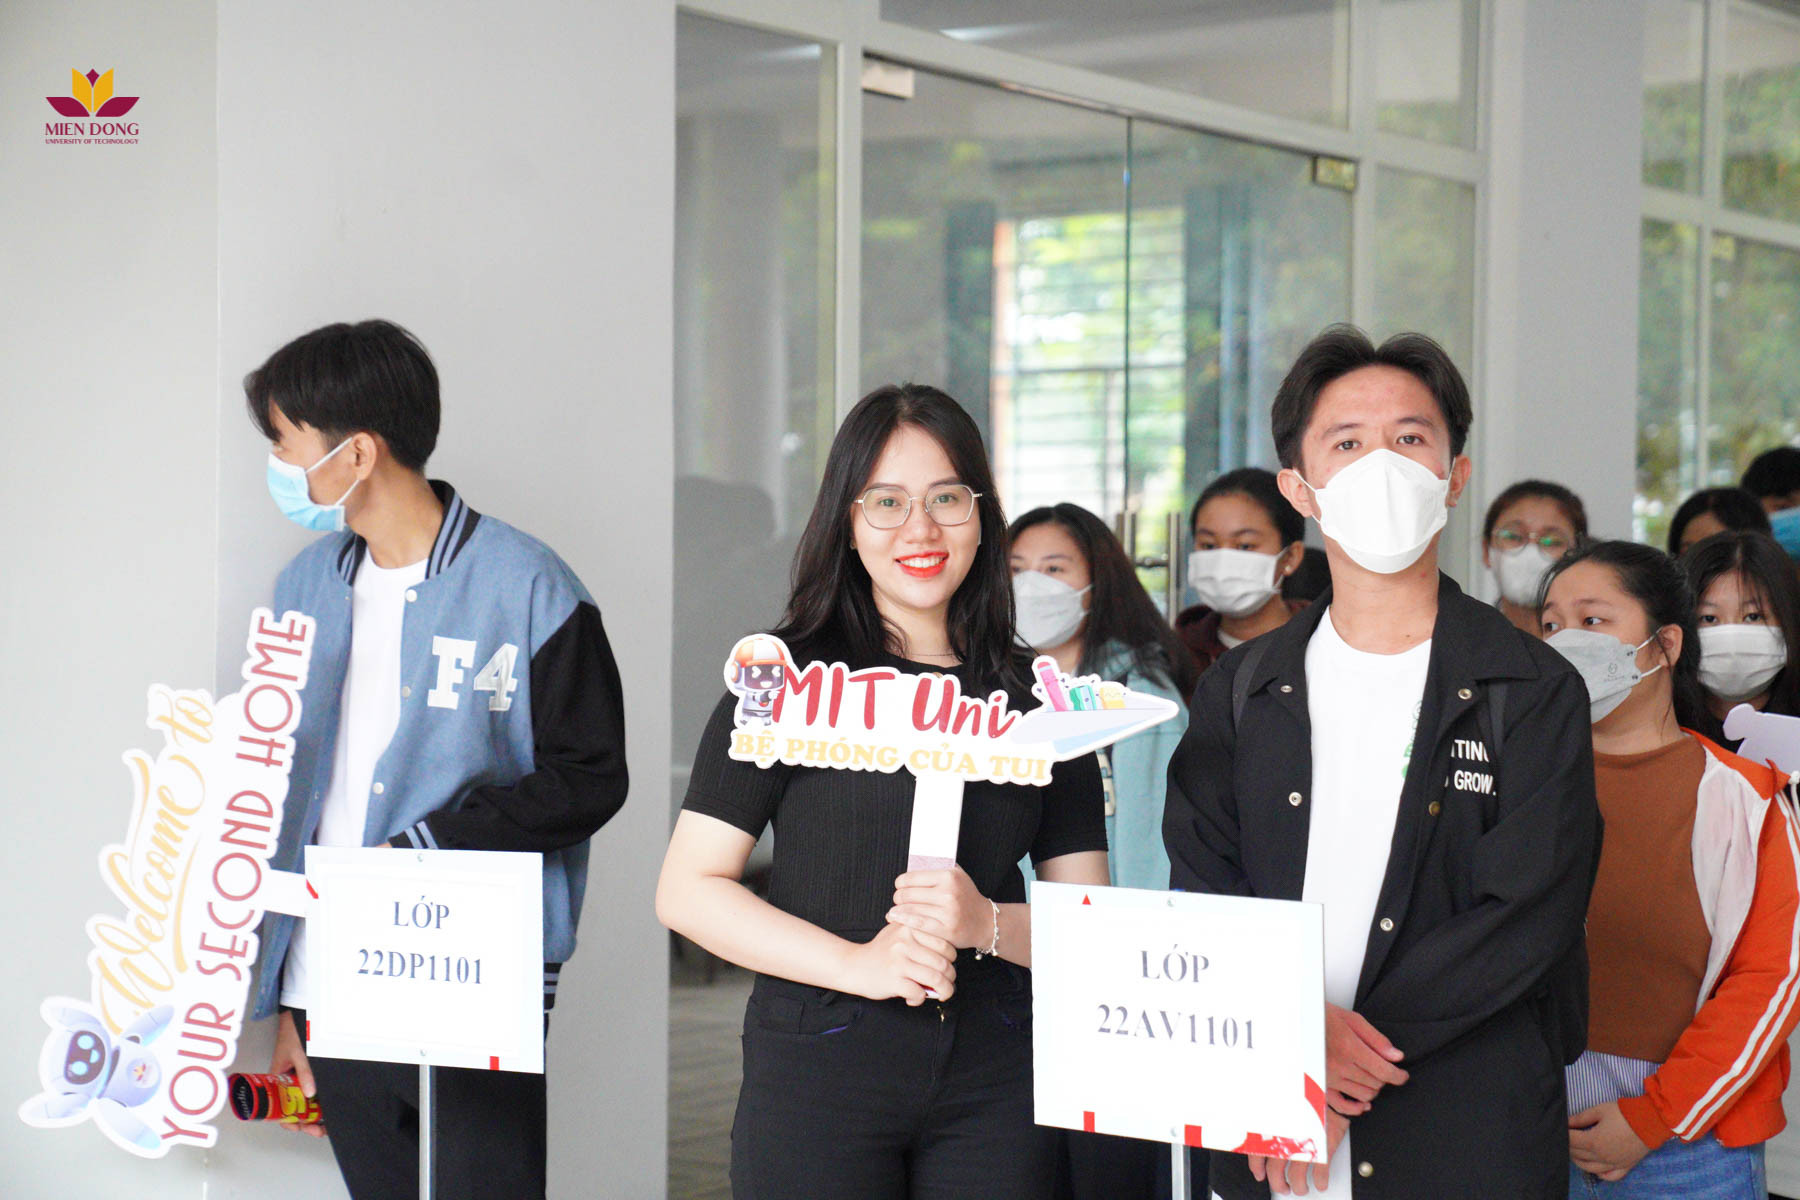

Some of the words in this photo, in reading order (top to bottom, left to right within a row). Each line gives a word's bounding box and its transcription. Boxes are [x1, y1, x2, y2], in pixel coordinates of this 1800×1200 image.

[236, 615, 308, 768] HOME
[427, 635, 519, 711] F4
[772, 666, 895, 730] MIT
[912, 677, 1017, 739] Uni
[735, 730, 775, 763] BỆ
[784, 737, 899, 767] PHÓNG
[909, 742, 978, 775] CỦA
[989, 755, 1047, 780] TUI
[95, 754, 206, 1035] Welcome
[155, 690, 213, 748] to
[195, 790, 274, 981] SECOND
[392, 895, 450, 929] LỚP
[357, 948, 482, 985] 22DP1101
[1140, 943, 1210, 983] LỚP
[1096, 1004, 1254, 1050] 22AV1101
[160, 1002, 235, 1140] YOUR
